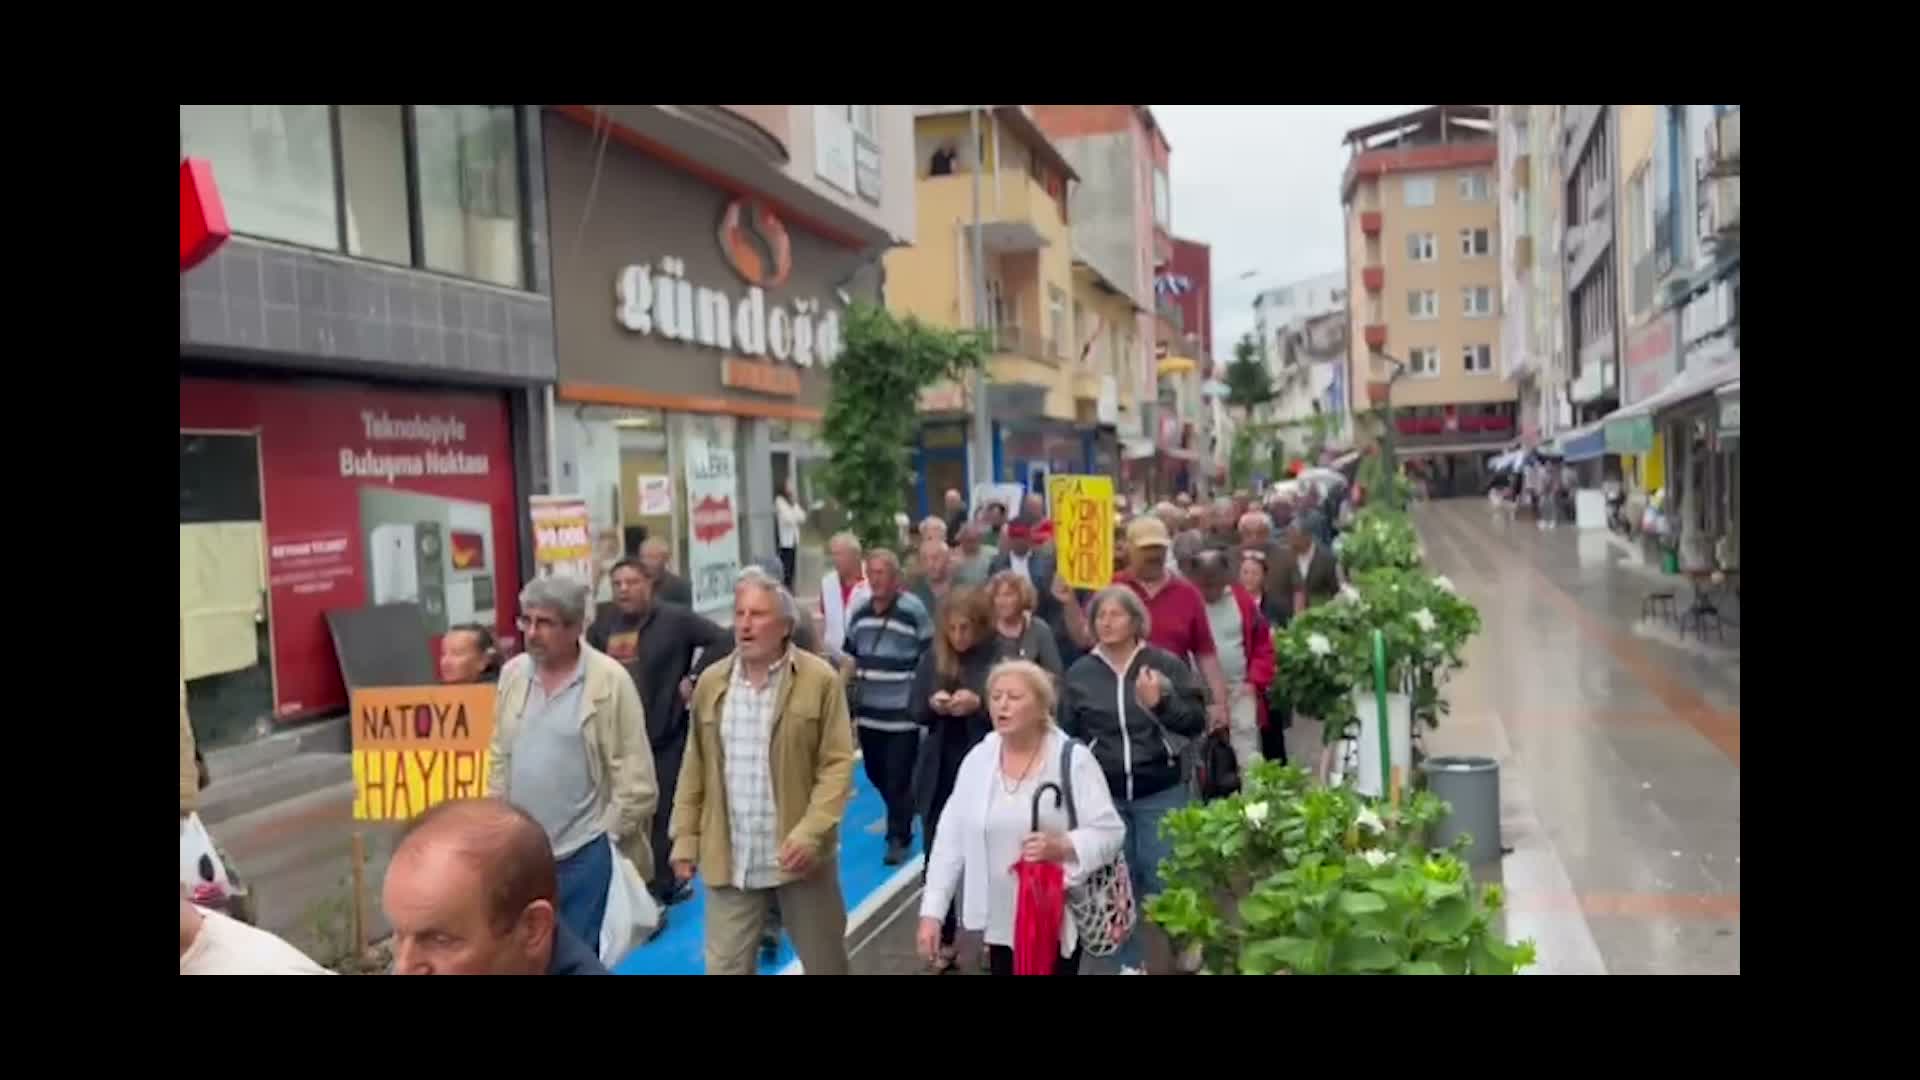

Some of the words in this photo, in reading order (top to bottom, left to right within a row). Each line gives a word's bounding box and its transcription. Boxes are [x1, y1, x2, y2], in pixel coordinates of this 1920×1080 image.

[360, 410, 466, 446] Teknolojiyle
[339, 448, 424, 484] Buluşma
[425, 449, 489, 475] Noktası
[362, 703, 470, 740] NATOYA
